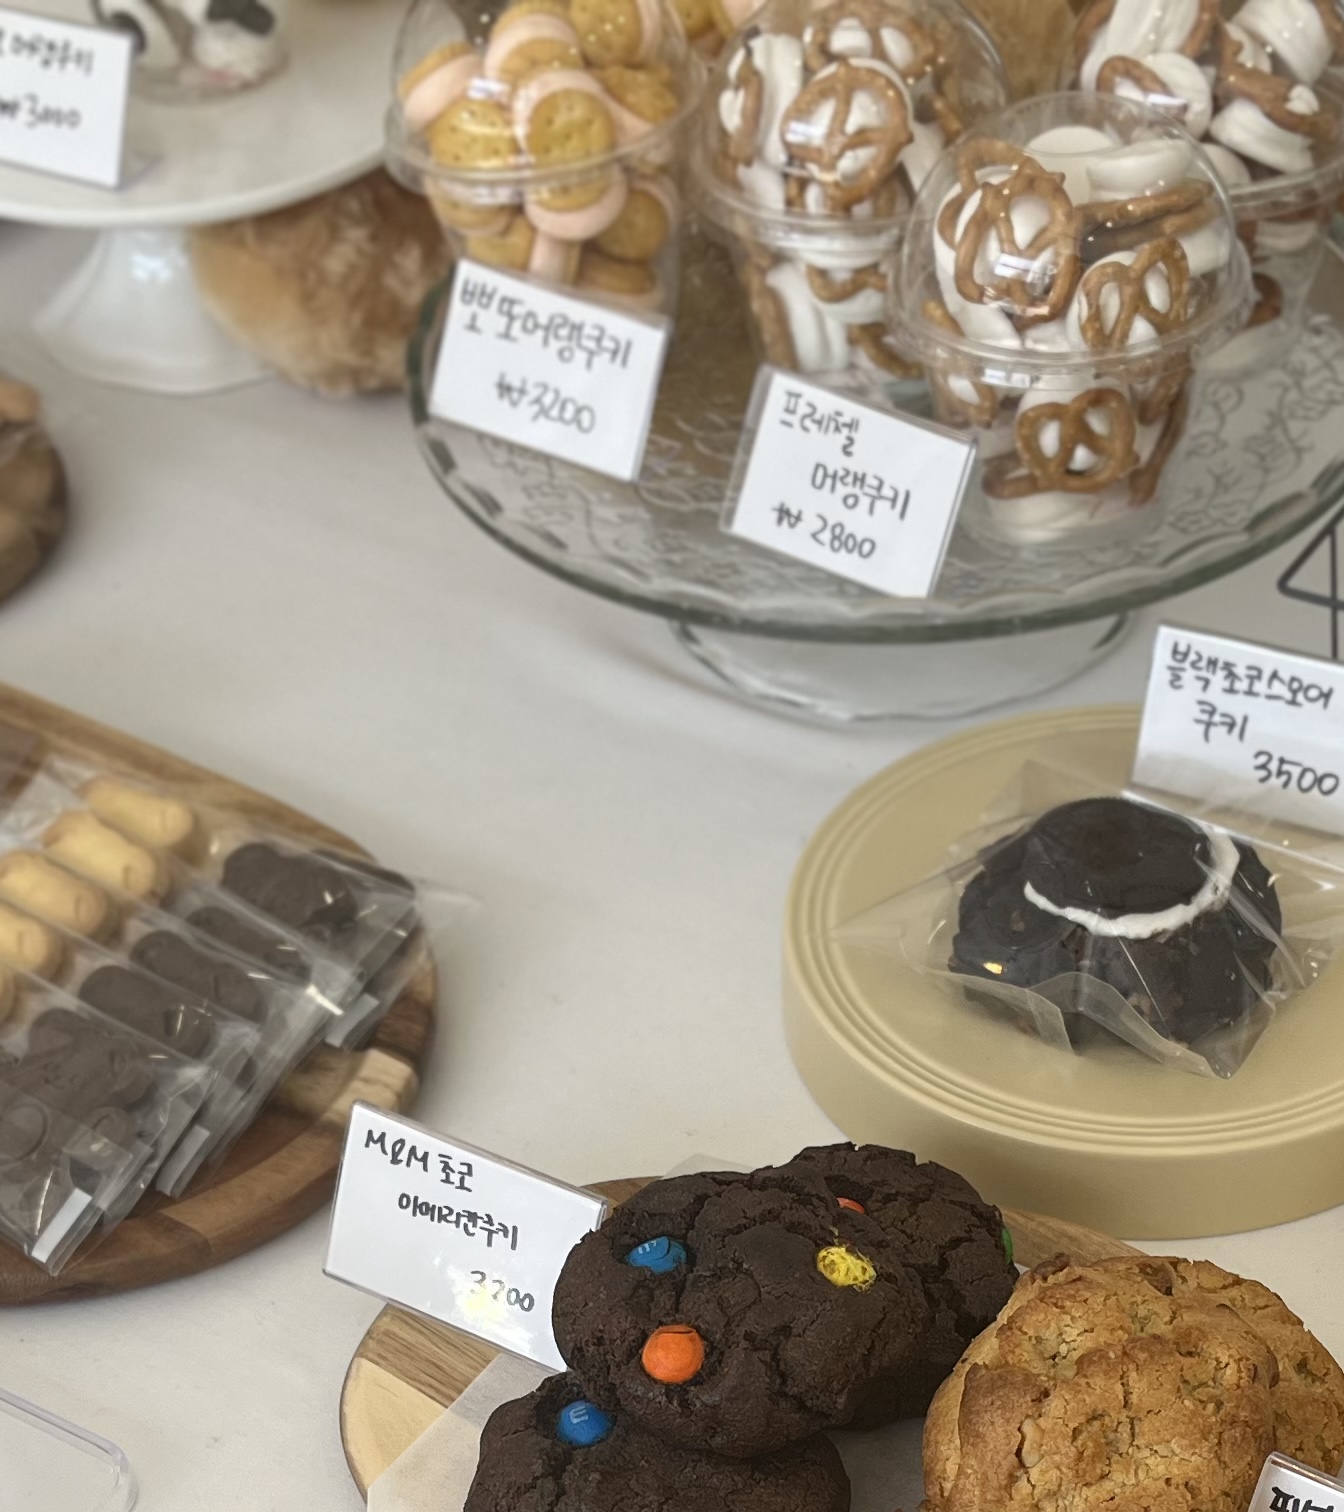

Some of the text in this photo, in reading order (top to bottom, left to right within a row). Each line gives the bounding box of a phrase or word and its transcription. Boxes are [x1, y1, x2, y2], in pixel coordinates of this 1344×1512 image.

[779, 390, 859, 457] 프레첼
[811, 463, 910, 521] 머랭쿠키
[1193, 699, 1249, 743] 쿠키
[1253, 750, 1340, 796] 3500
[364, 1129, 473, 1192] M&M 초코
